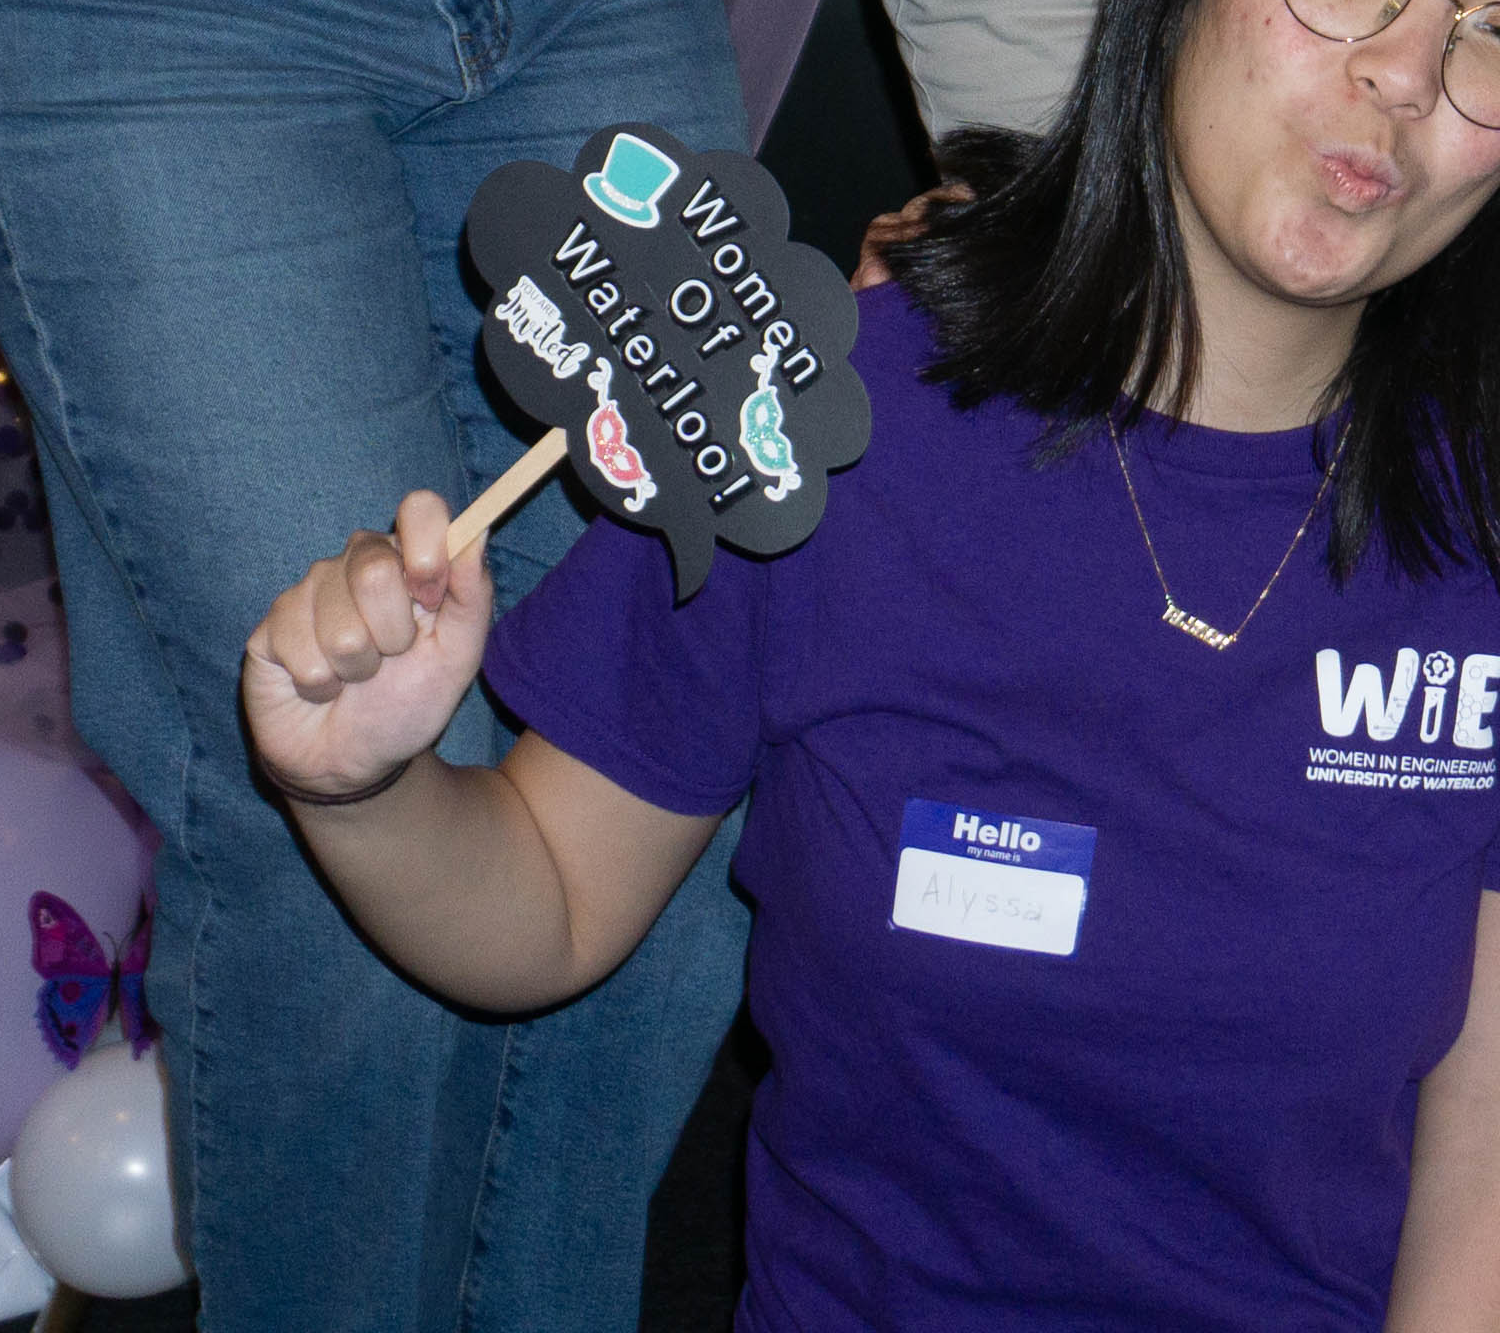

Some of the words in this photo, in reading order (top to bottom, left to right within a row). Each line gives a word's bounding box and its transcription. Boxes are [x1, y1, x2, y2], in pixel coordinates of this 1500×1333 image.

[520, 280, 539, 301] YOU
[537, 299, 557, 318] ARE
[682, 180, 821, 385] Women
[500, 289, 585, 372] Invited
[670, 279, 742, 352] Of
[555, 222, 751, 504] Waterloo!
[1306, 766, 1398, 789] UNIVERSITY
[1398, 775, 1422, 790] OF
[1422, 775, 1495, 790] WATERLOO
[1309, 746, 1376, 769] WOMEN
[1379, 754, 1397, 771] IN
[1400, 756, 1496, 775] ENGINEERING
[953, 812, 1041, 852] Hello
[967, 845, 982, 860] my
[983, 849, 1011, 862] name
[1012, 851, 1021, 863] is
[921, 870, 1043, 925] Alyssa
